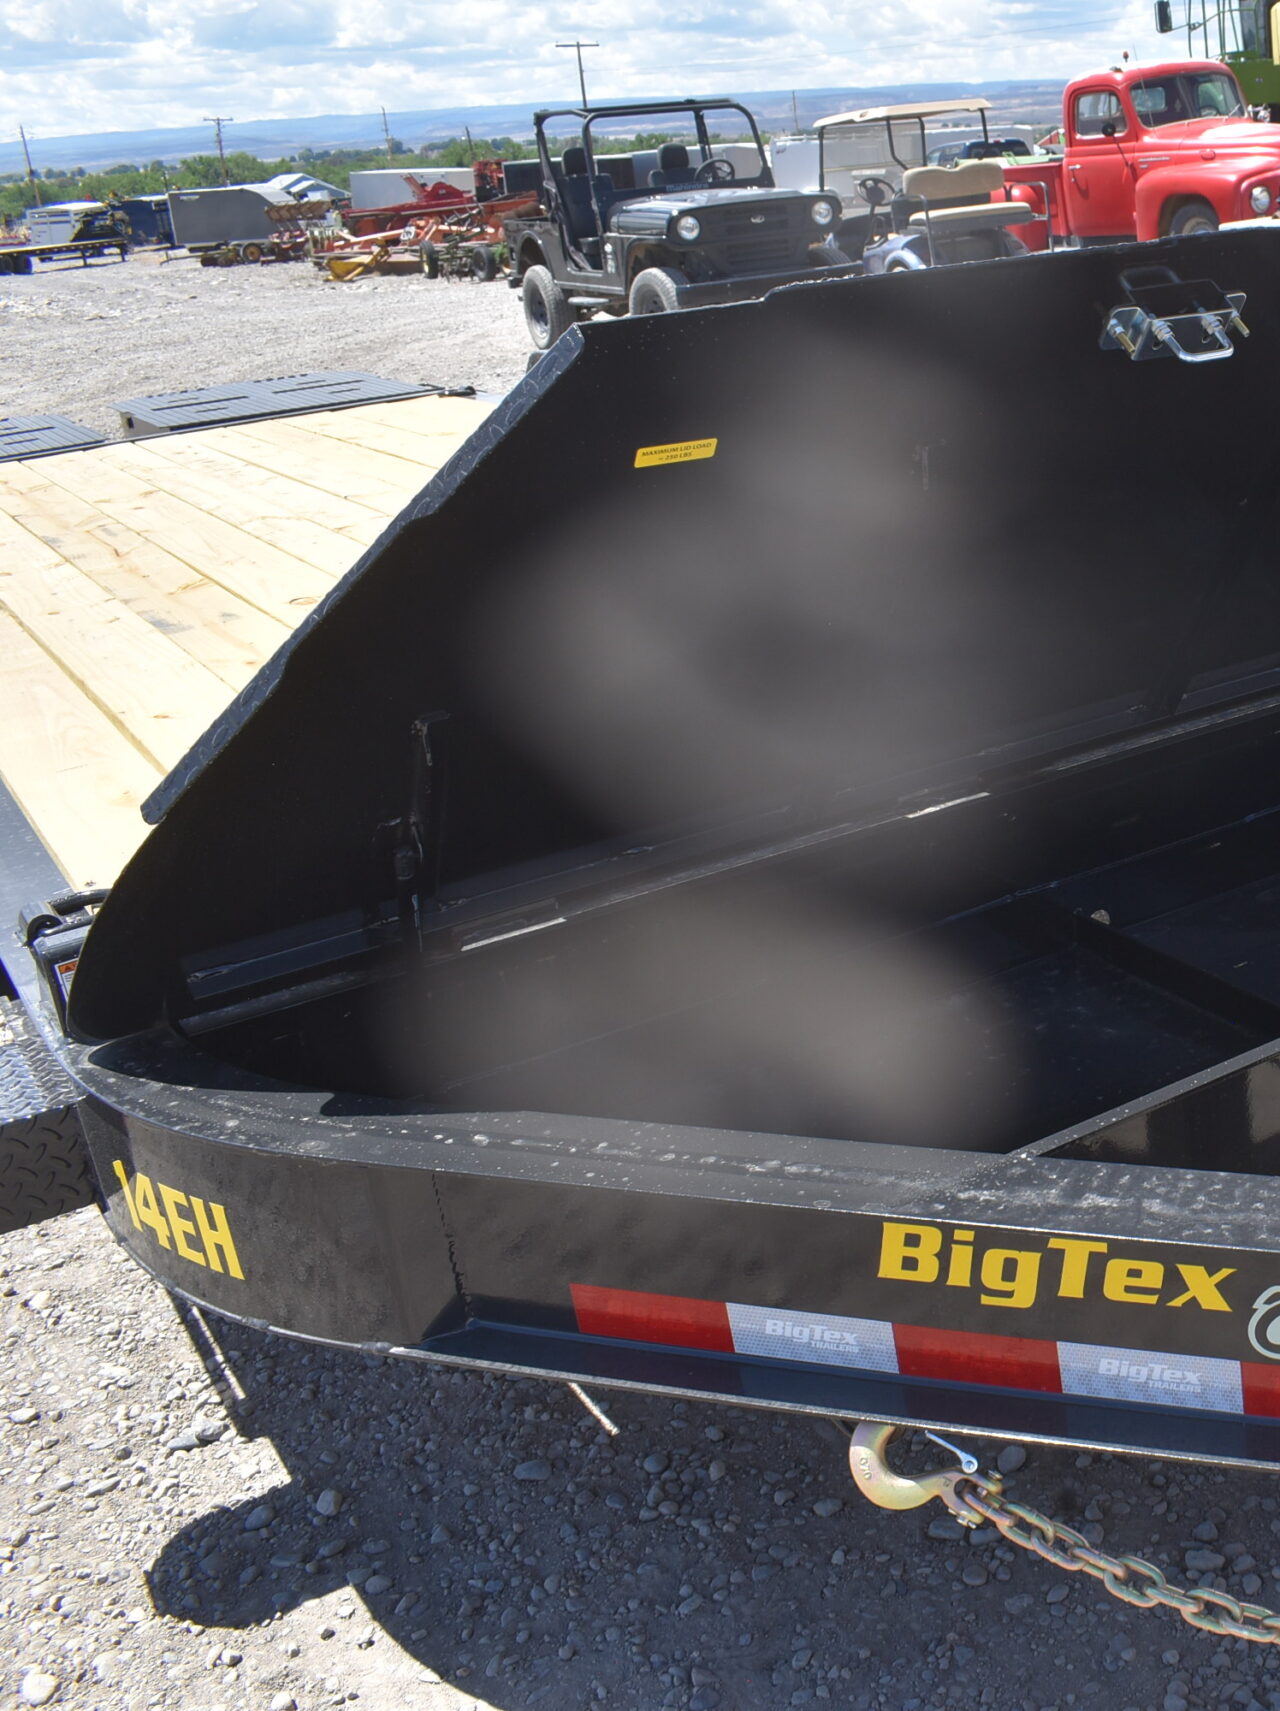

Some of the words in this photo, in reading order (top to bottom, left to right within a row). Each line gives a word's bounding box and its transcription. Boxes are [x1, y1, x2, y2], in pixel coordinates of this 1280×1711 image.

[641, 447, 679, 457] MAXIMUM
[692, 442, 712, 450] LOAD
[112, 1159, 246, 1281] 14EH
[877, 1221, 1238, 1313] BigTex
[765, 1319, 858, 1345] BigTex
[811, 1341, 860, 1353] TRAILERS
[1098, 1358, 1201, 1385] BigTex
[1149, 1380, 1201, 1393] TRAILERS
